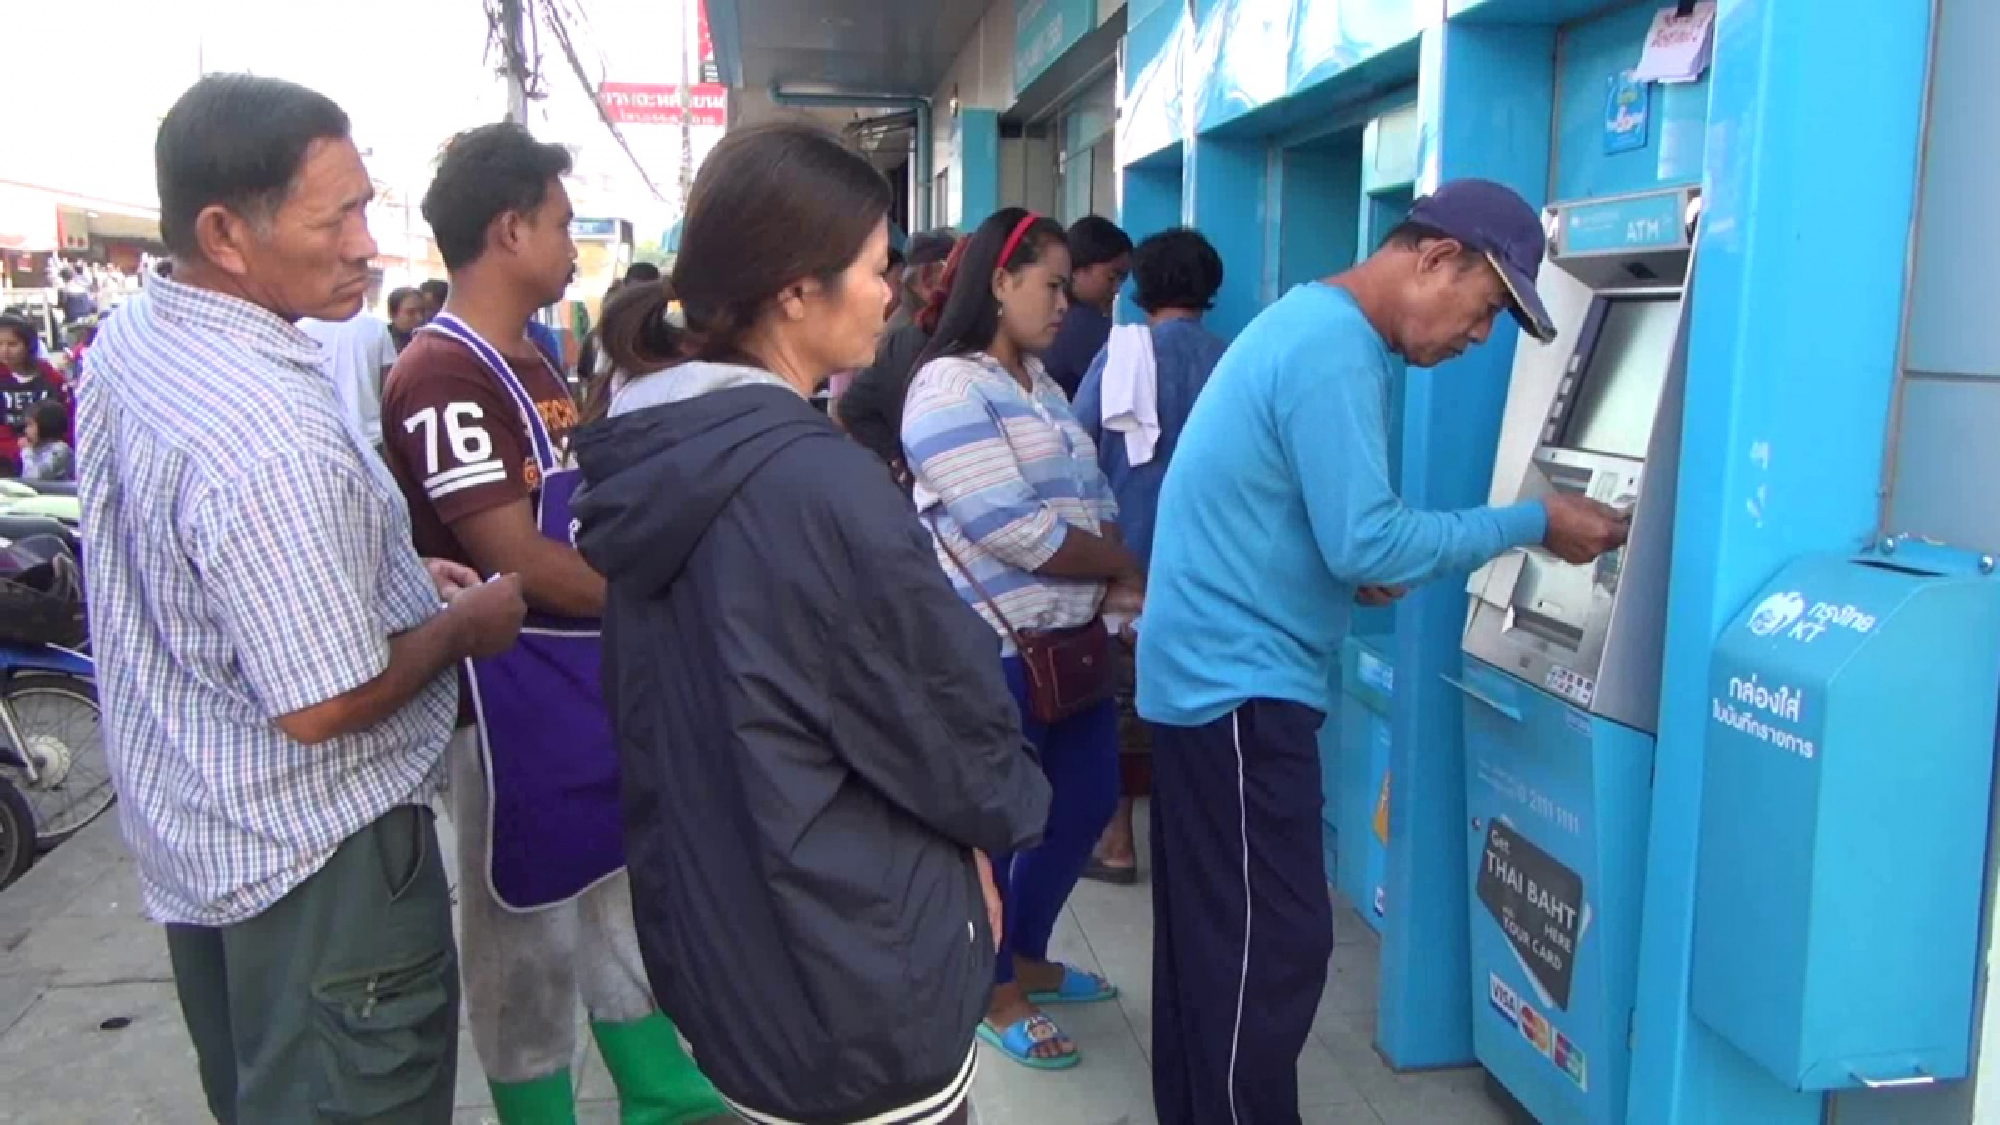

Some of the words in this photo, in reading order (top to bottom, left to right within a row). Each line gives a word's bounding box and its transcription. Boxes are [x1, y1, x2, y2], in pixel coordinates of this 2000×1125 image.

[1626, 219, 1660, 242] ATM
[403, 402, 493, 475] 76
[1807, 602, 1876, 633] กรุงไทย
[1729, 672, 1802, 723] กล่องใส่
[1712, 697, 1813, 759] ใบบันทึกรายการ
[1487, 849, 1524, 895] THAI
[1526, 879, 1577, 931] BAHT
[1502, 917, 1531, 948] YOUR
[1532, 938, 1563, 972] CARD
[1544, 922, 1573, 954] HERE
